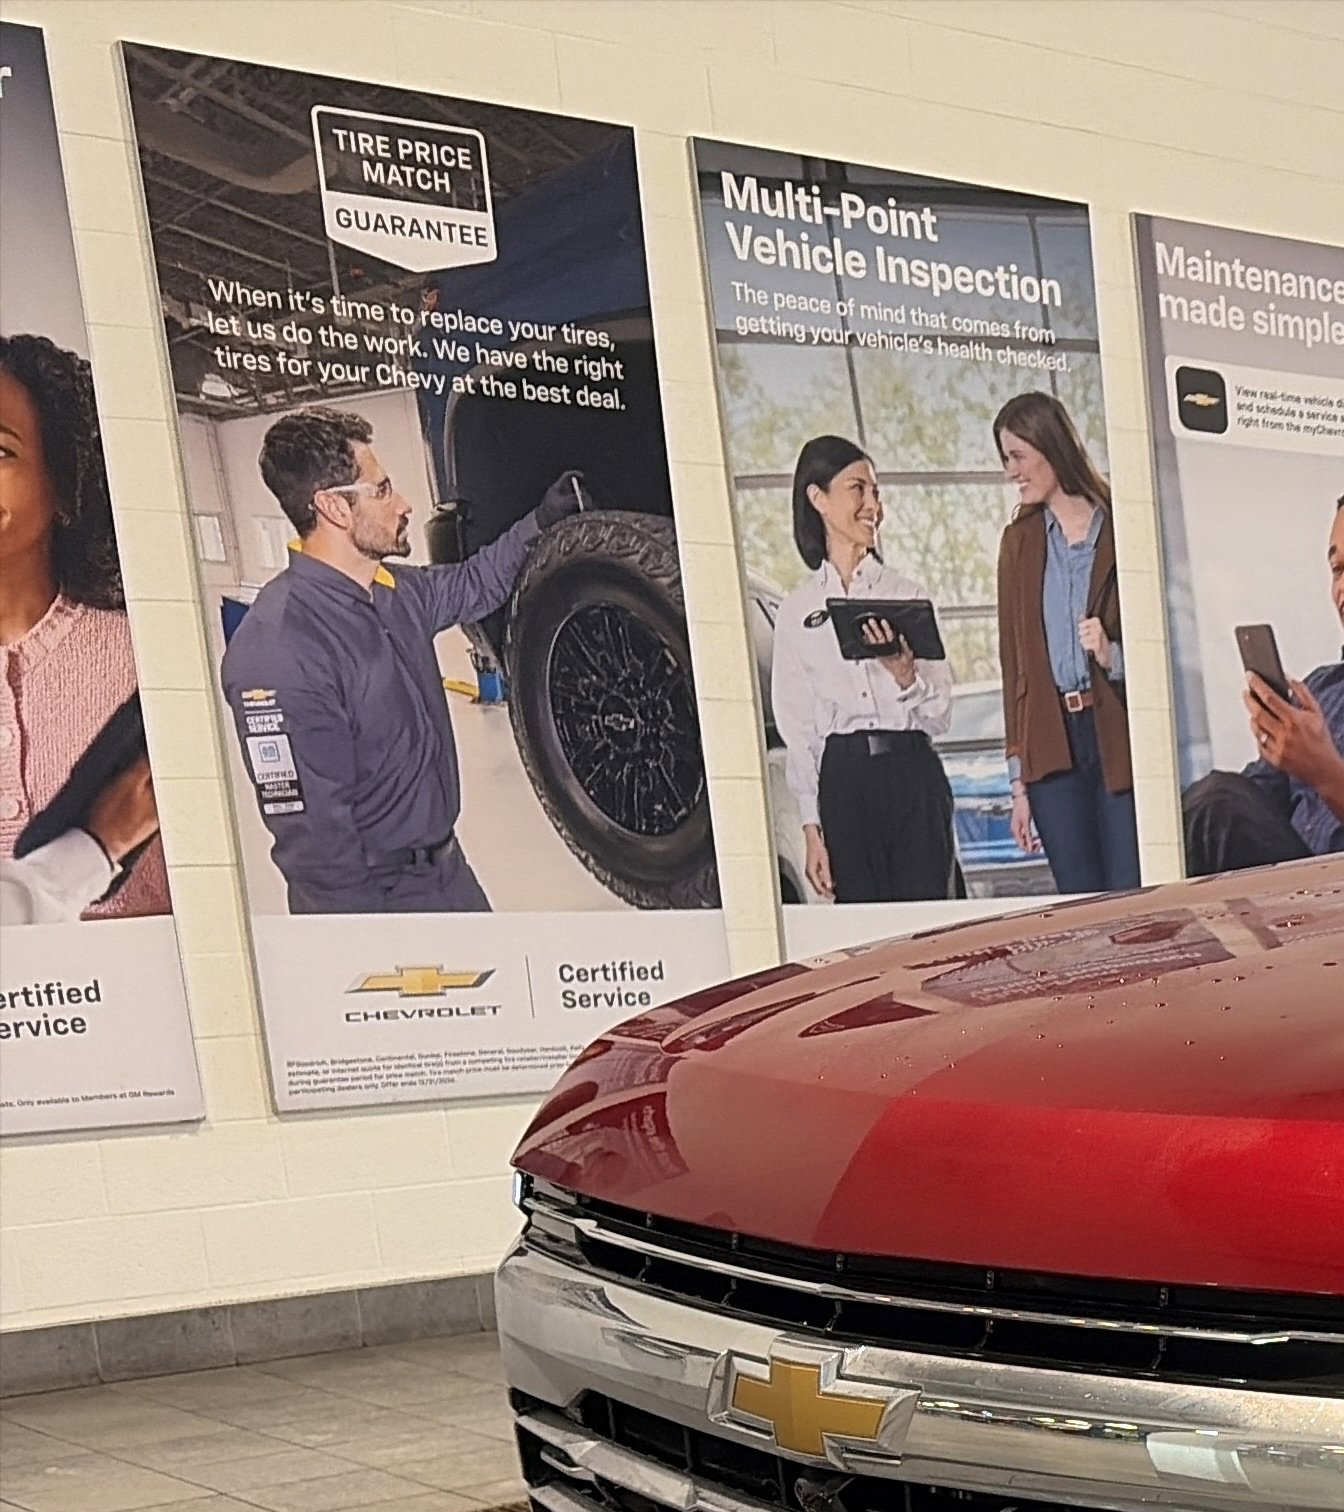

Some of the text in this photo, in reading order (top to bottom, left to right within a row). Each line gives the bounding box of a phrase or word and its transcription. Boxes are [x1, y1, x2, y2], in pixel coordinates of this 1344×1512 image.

[332, 128, 472, 170] TIRE PRICE
[363, 160, 450, 193] MATCH
[336, 208, 488, 247] GUARANTEE
[721, 170, 938, 242] Multi-Point
[725, 221, 1062, 306] Vehicle Inspection
[207, 279, 615, 352] When it's time to replace your tires,
[731, 280, 1056, 344] The peace of mind that comes from
[1158, 291, 1246, 331] made
[207, 311, 624, 381] let us do the work. We have the right
[736, 314, 805, 343] getting
[810, 326, 851, 345] your
[938, 336, 992, 362] health
[997, 346, 1072, 373] checked.
[214, 345, 626, 410] tires for your Chevy at the best deal.
[558, 959, 665, 984] Certified
[345, 1005, 502, 1024] CHEVROLET
[561, 988, 650, 1010] Service
